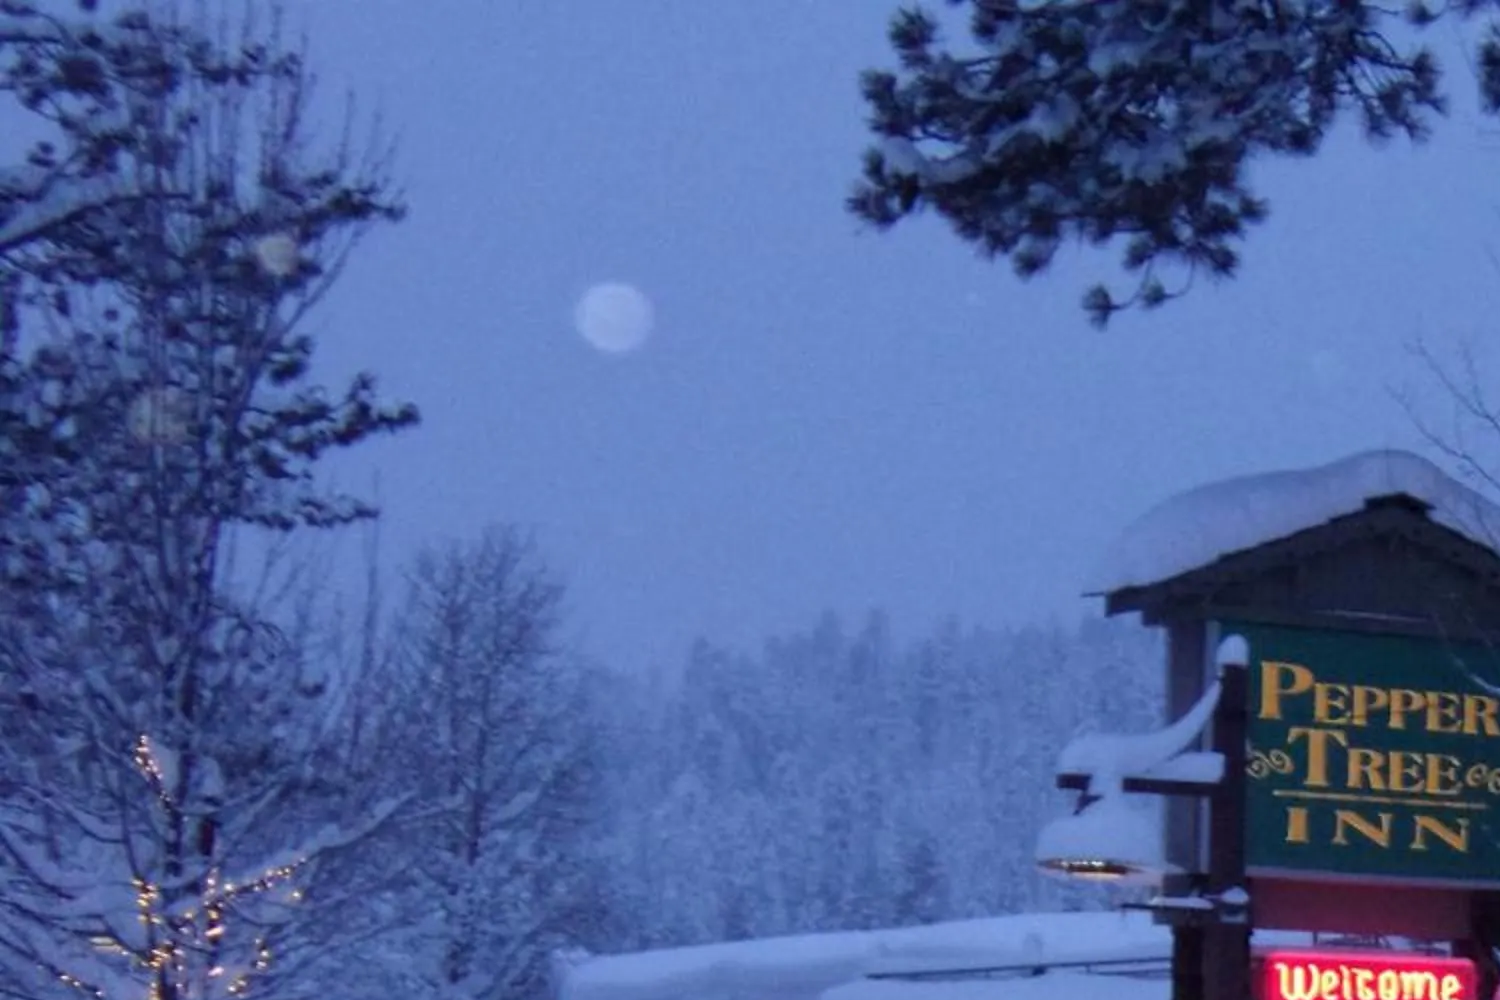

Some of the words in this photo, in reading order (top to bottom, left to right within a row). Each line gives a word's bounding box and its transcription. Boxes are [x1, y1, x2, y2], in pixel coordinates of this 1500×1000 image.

[1259, 661, 1500, 736] PEPPER
[1288, 727, 1464, 796] TREE
[1285, 806, 1470, 852] INN
